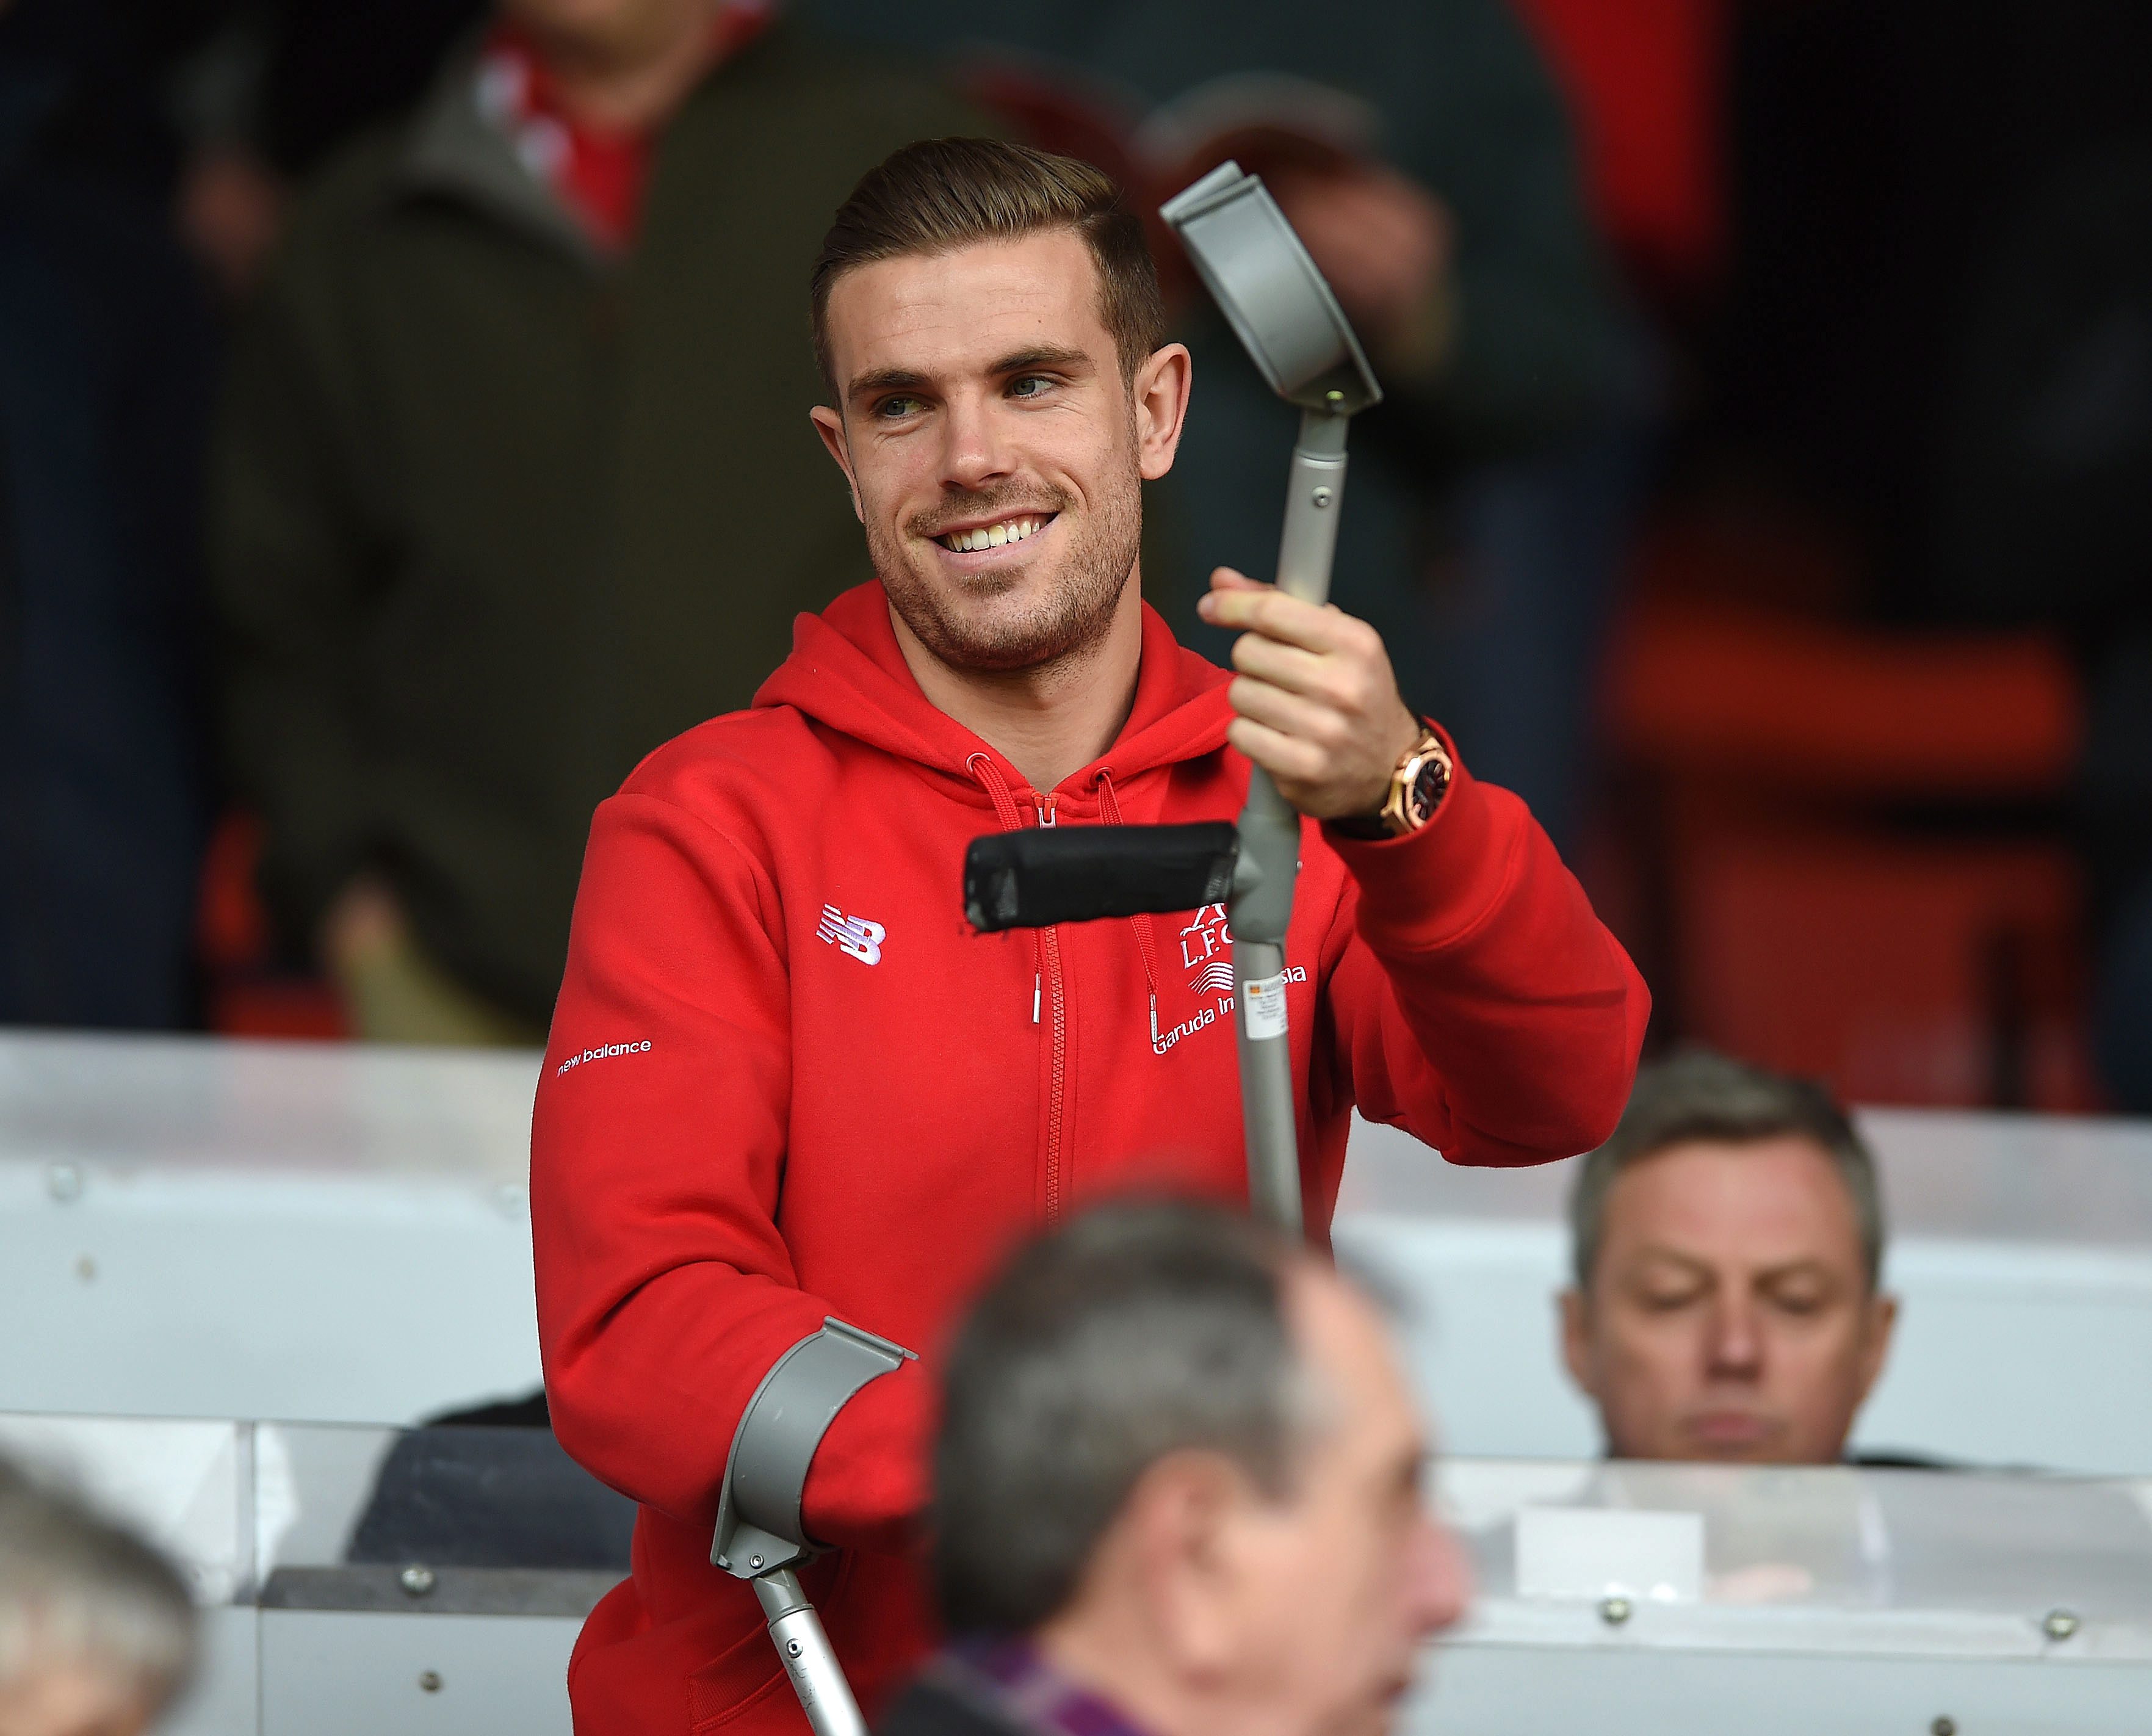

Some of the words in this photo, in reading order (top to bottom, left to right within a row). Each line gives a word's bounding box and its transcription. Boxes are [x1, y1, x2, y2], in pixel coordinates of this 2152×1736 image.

[1154, 1009, 1215, 1055] Garuda
[557, 1054, 582, 1077] new
[583, 1040, 651, 1063] balance
